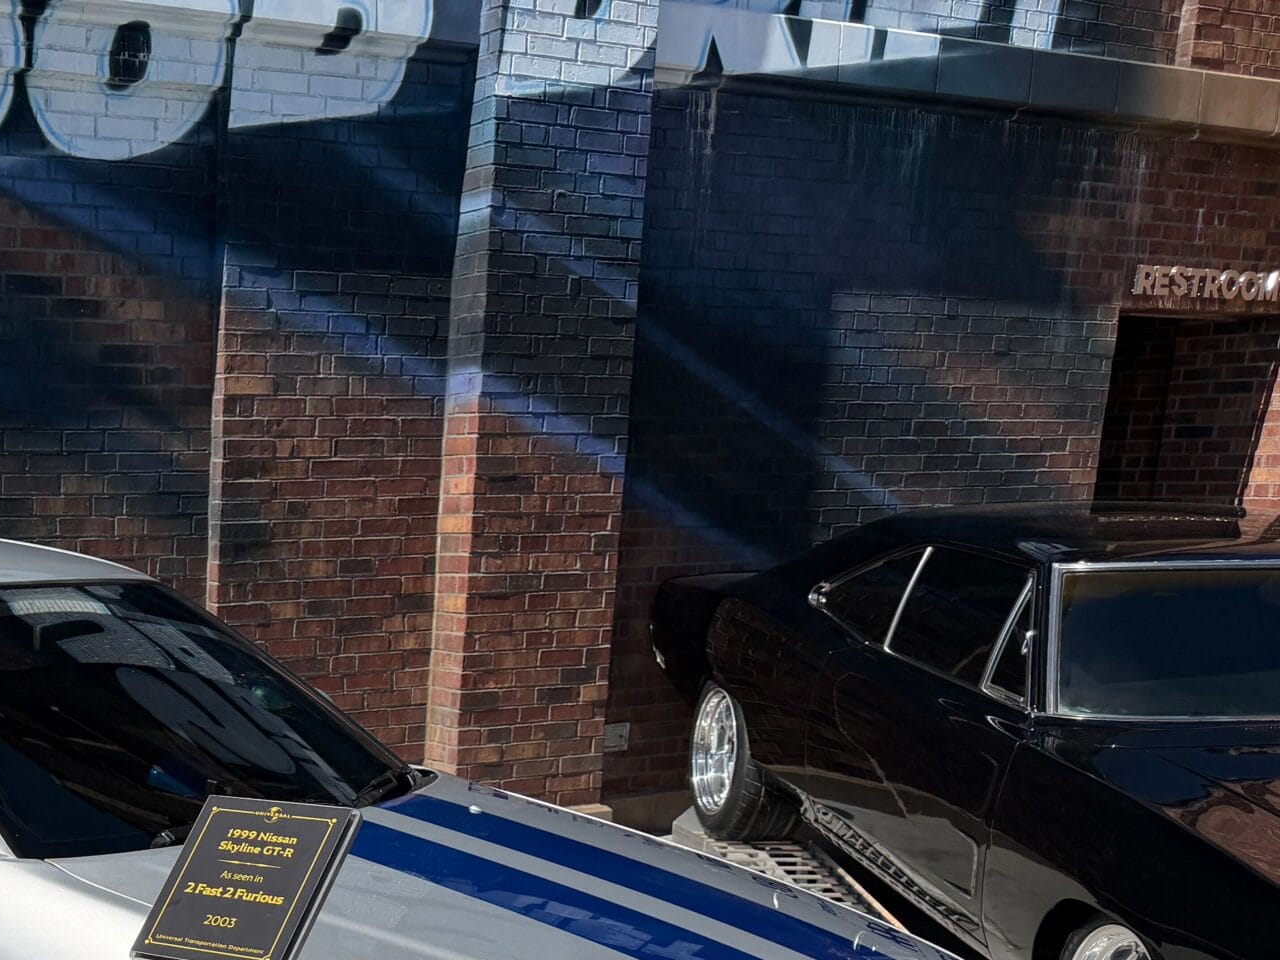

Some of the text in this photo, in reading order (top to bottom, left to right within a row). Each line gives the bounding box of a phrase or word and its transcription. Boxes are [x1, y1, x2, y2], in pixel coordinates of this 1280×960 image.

[227, 828, 298, 845] 1999 Nissan
[218, 840, 294, 858] Skyline GT-R
[220, 870, 264, 883] As seen in
[184, 882, 285, 905] 2 Fast 2 Furious
[203, 914, 237, 928] 2003
[156, 933, 265, 955] Universal Transportation Department
